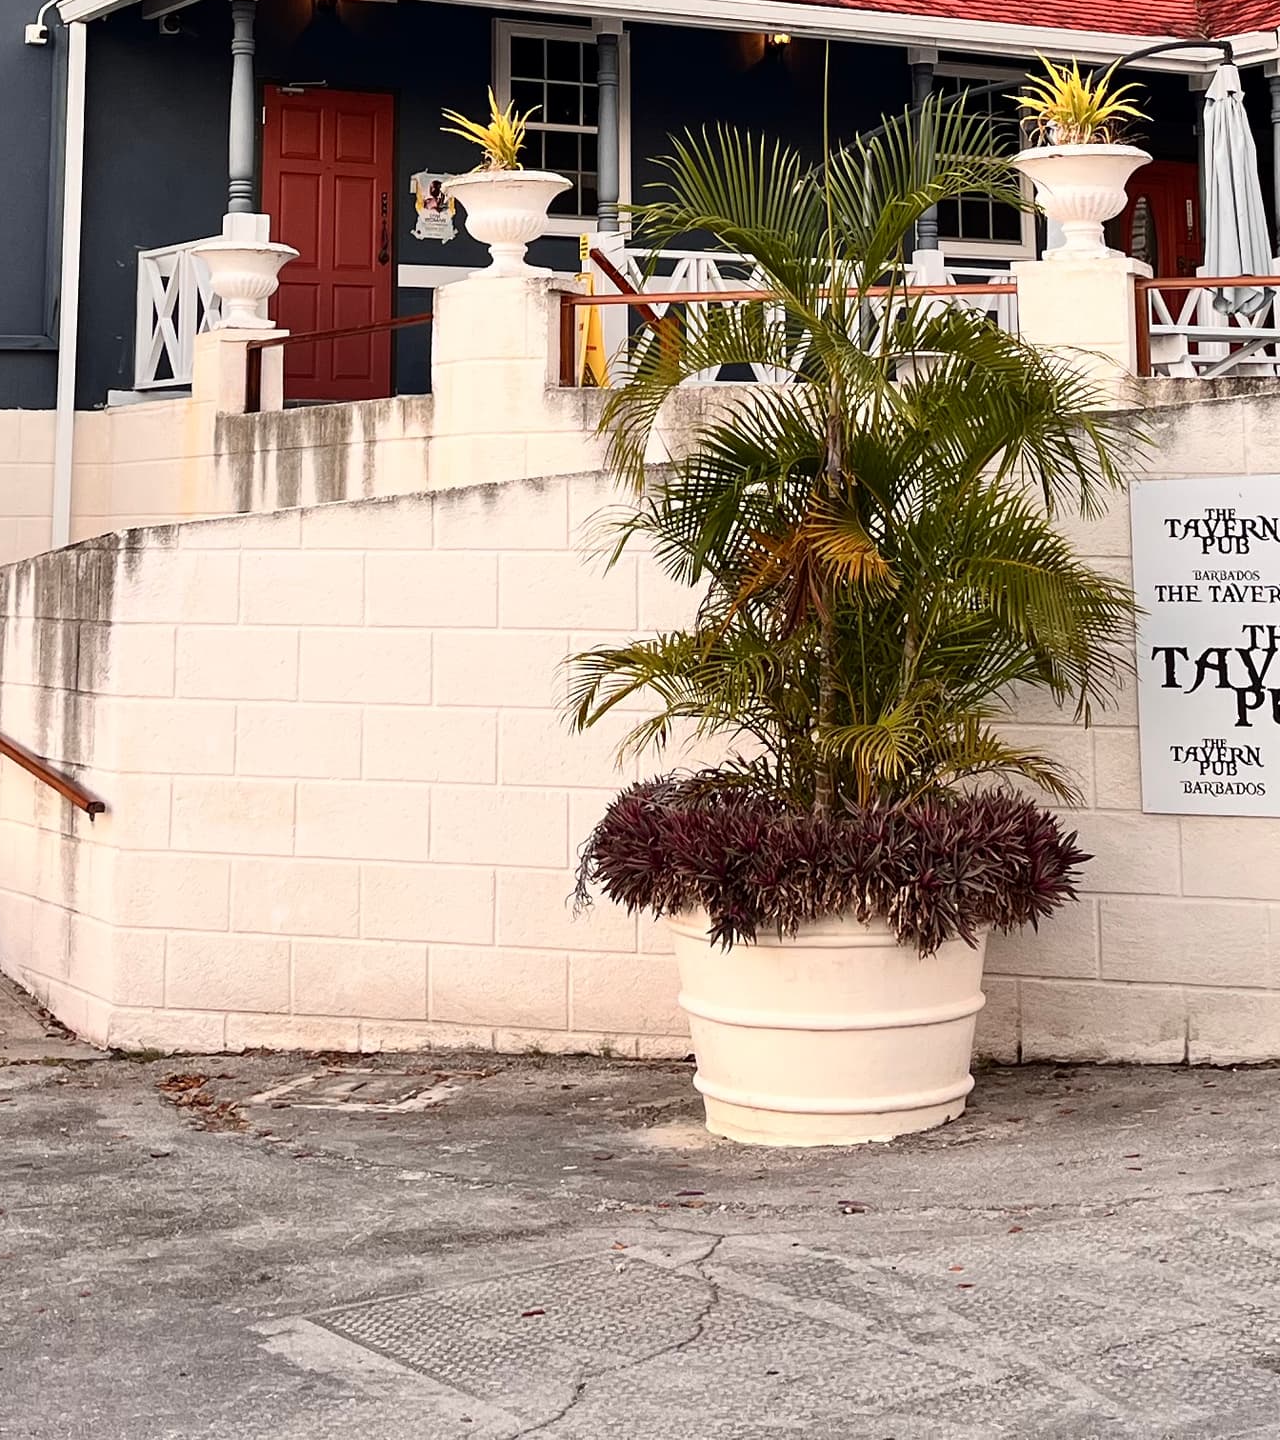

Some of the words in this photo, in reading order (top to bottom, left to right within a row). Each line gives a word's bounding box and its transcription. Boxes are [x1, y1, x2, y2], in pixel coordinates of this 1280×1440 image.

[1204, 508, 1236, 520] THE
[1201, 536, 1250, 555] PUB
[1192, 570, 1260, 582] BARBADOS
[1154, 585, 1202, 603] THE
[1202, 738, 1227, 748] THE
[1170, 744, 1264, 767] TAVERN
[1199, 760, 1238, 776] PUB
[1180, 780, 1266, 798] BARBADOS
